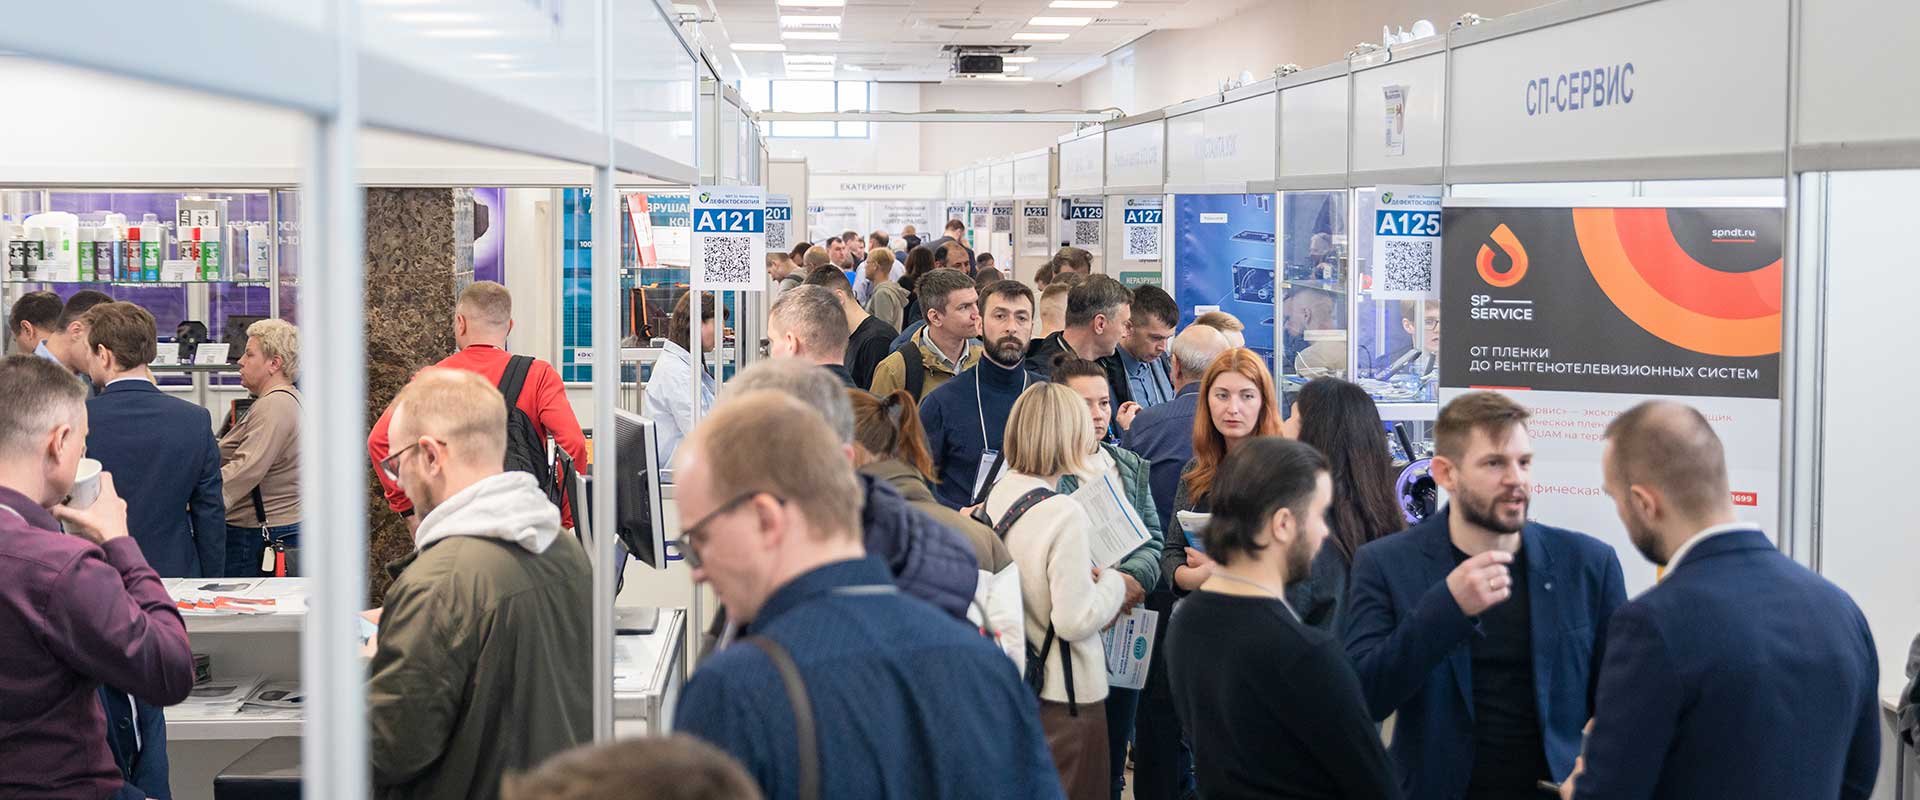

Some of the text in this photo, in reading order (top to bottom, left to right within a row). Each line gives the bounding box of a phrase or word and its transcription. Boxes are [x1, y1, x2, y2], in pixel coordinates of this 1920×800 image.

[1526, 62, 1634, 116] СП-СЕРВИС
[840, 183, 906, 191] ЕКАТЕРИНБУРГ
[765, 208, 788, 220] 201
[1025, 208, 1047, 216] A231
[1072, 207, 1103, 218] A129
[1126, 210, 1161, 223] A127
[697, 211, 755, 231] A121
[1378, 212, 1440, 235] A125
[1711, 227, 1756, 238] spndt.ru
[1470, 295, 1490, 306] SP
[1470, 308, 1533, 320] SERVICE
[1470, 346, 1549, 358] ОТ ПЛЕНКИ
[1469, 360, 1759, 379] ДО РЕНТГЕНОТЕЛЕВИЗИОННЫХ СИСТЕМ
[1531, 483, 1600, 496] фическая
